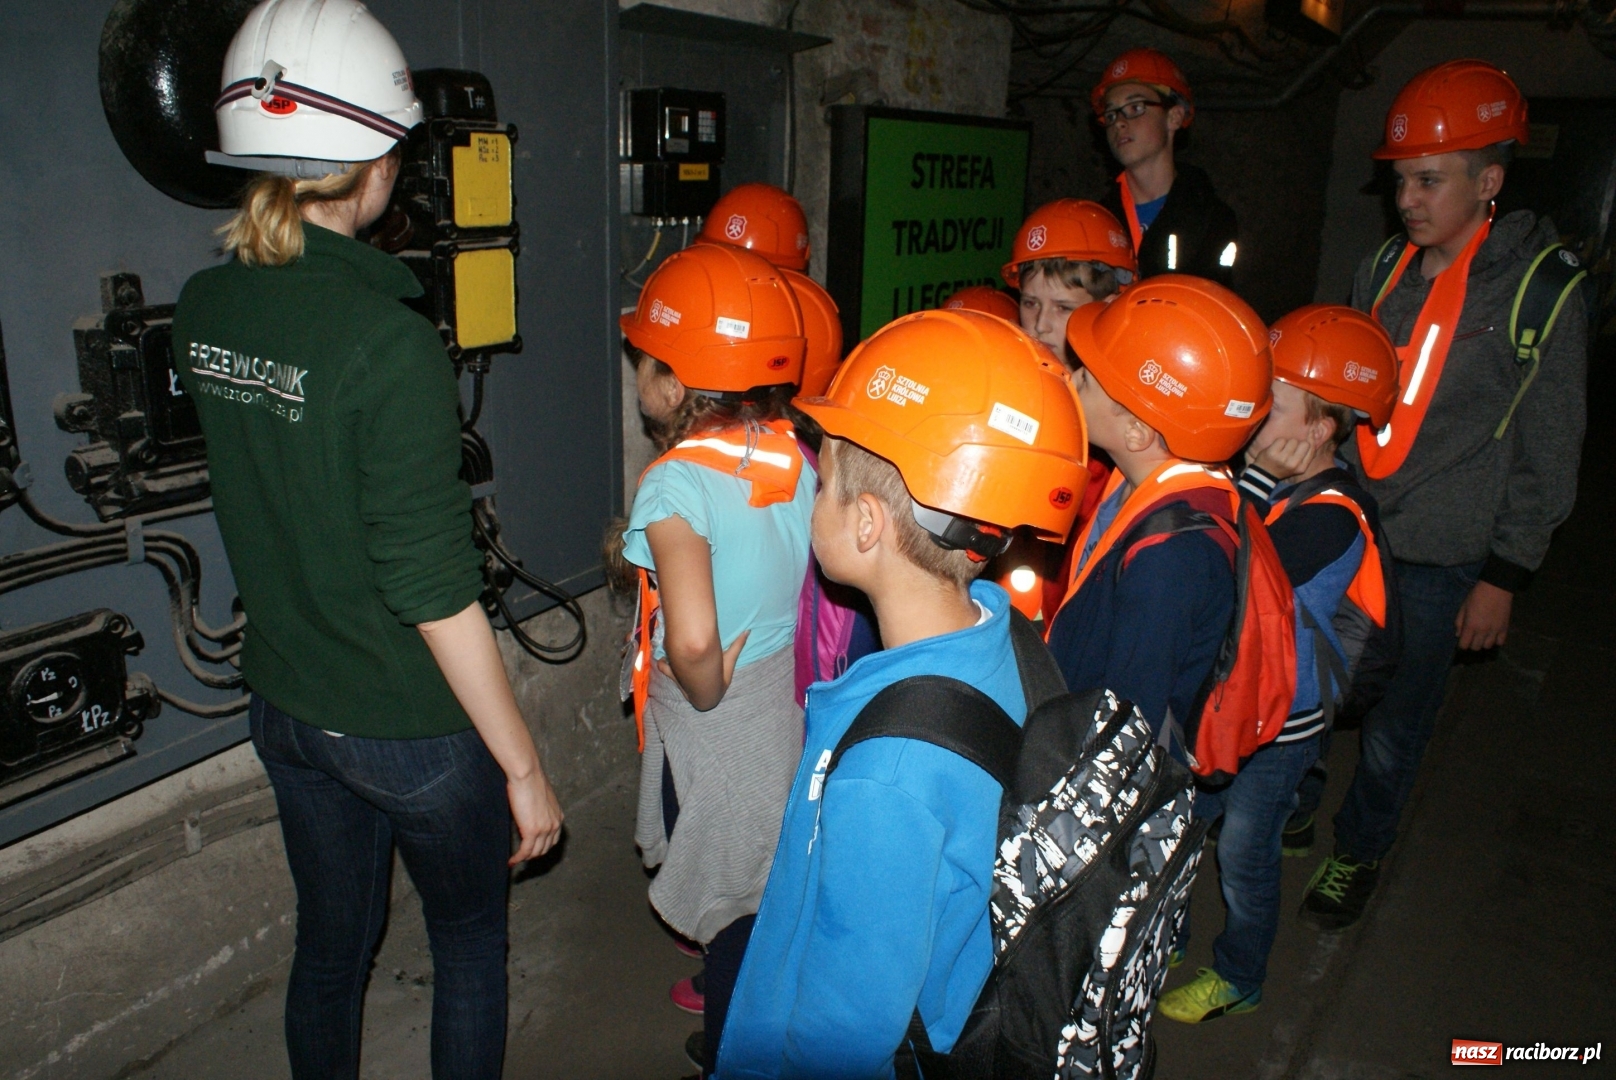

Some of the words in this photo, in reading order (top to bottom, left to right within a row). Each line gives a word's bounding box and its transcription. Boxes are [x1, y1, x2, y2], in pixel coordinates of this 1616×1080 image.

[911, 152, 996, 190] STREFA
[892, 216, 1004, 257] TRADYCJI
[189, 342, 308, 396] PRZEWODNIK
[772, 357, 787, 367] JSP
[891, 383, 925, 405] KRÓLOWA
[895, 375, 930, 397] SZTOLNIA
[886, 391, 907, 407] LUIZA
[1053, 490, 1071, 504] JSP
